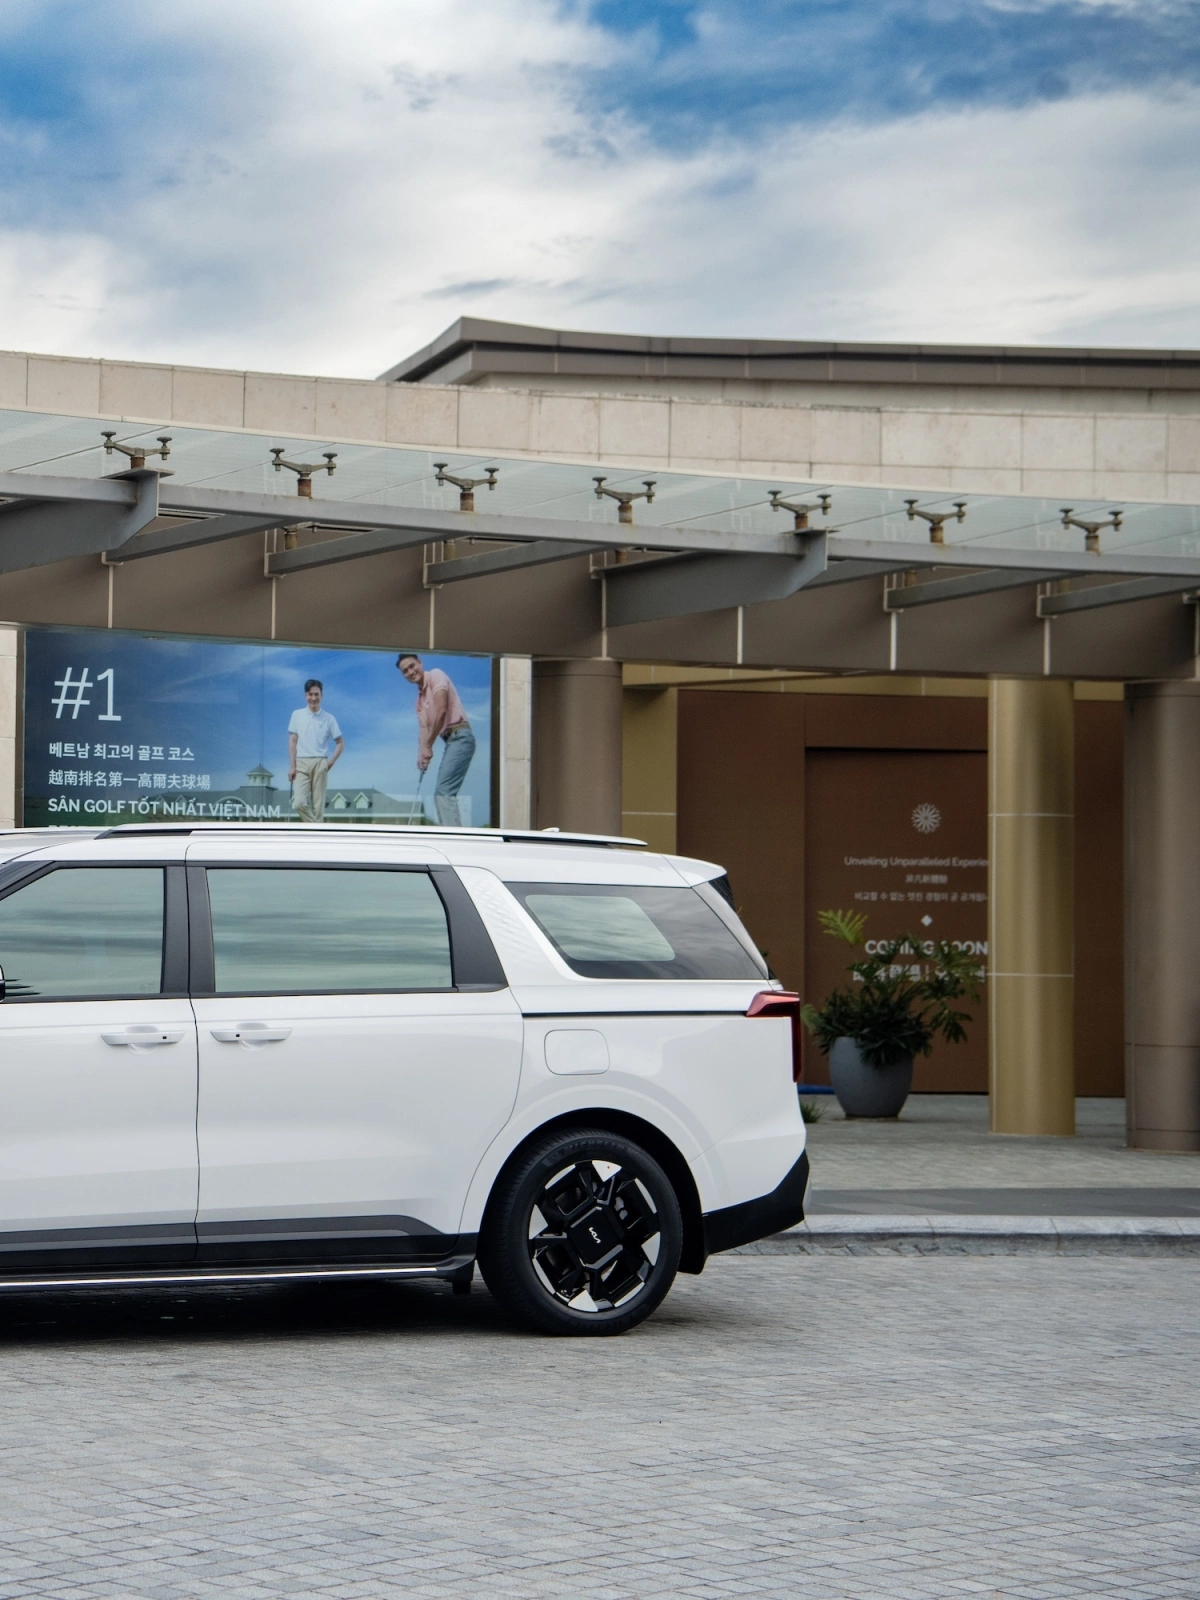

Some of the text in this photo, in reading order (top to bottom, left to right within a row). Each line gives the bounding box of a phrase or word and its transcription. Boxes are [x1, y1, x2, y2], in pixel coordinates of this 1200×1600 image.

[51, 667, 122, 721] #1
[49, 741, 195, 761] 베트남 최고의 골프 코스
[48, 769, 211, 790] 越南排名第一高爾夫球場
[47, 794, 281, 821] SÂN GOLF TỐT NHẤT VIỆT NAM
[844, 857, 888, 868] Unveiling
[890, 857, 950, 868] Unparalleled
